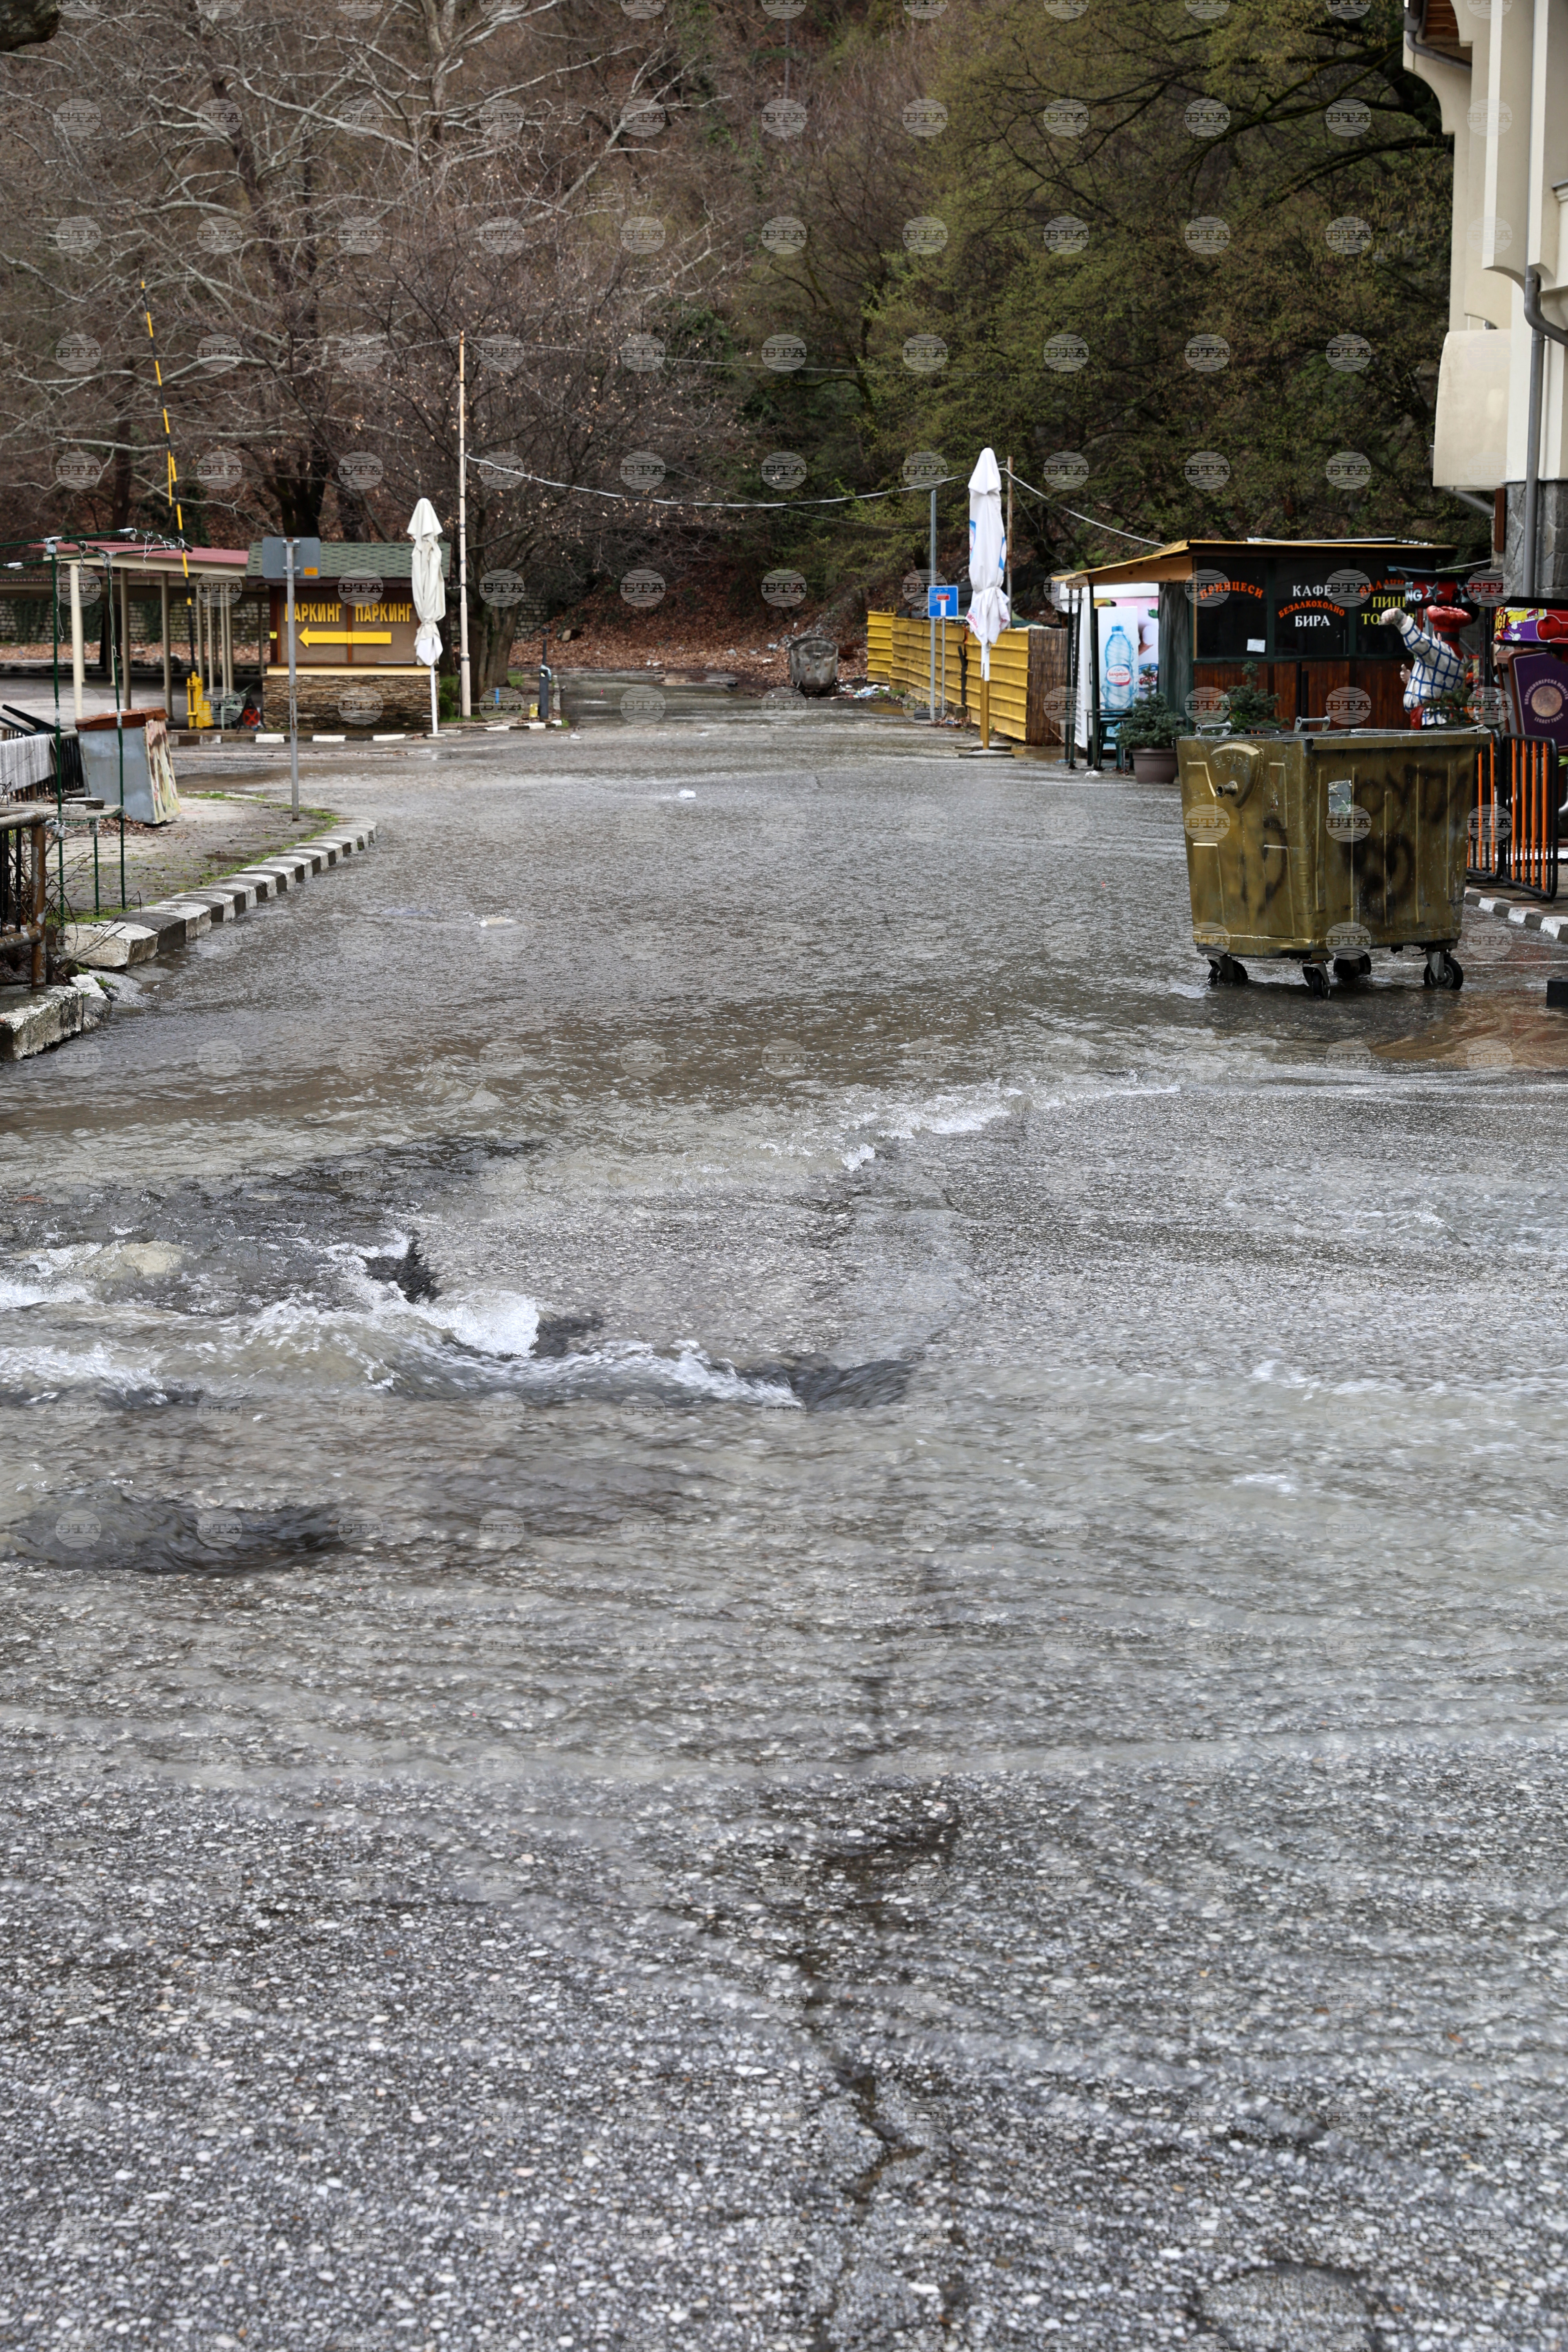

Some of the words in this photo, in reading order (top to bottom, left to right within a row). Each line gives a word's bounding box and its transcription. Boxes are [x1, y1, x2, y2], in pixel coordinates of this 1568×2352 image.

[1200, 581, 1263, 599] ПРИНЦЕСИ
[1293, 585, 1332, 597] КАФЕ
[355, 603, 412, 622] ПАРКИНГ
[1278, 600, 1345, 619] БЕЗАЛКОХОЛНО
[1295, 615, 1330, 627] БИРА
